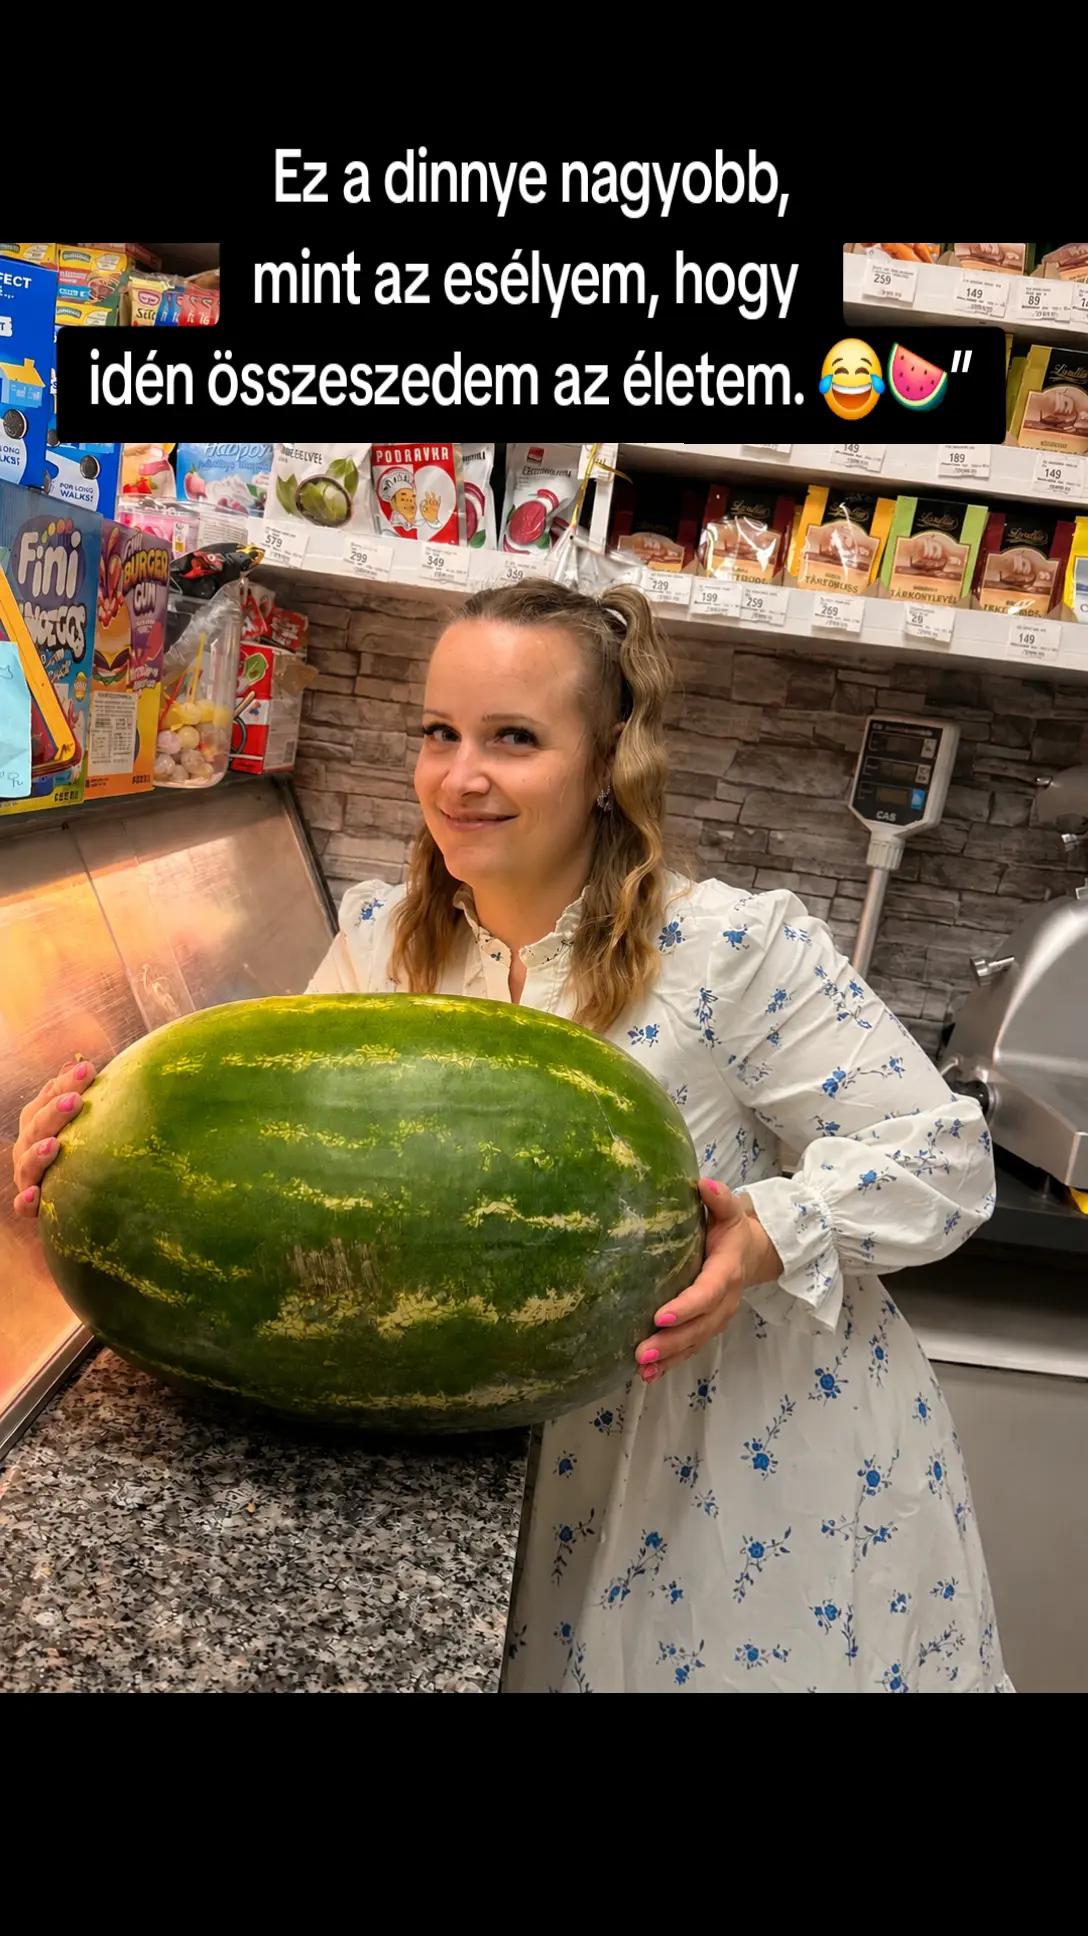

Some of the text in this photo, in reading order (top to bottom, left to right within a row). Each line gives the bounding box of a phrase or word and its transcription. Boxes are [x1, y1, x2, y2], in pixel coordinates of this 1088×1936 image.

[873, 273, 892, 285] 259
[966, 287, 983, 299] 149
[1027, 295, 1041, 306] 89
[376, 447, 449, 463] PODRAVKA
[949, 453, 965, 464] 189
[1044, 468, 1062, 480] 149
[74, 486, 94, 494] LONG
[265, 534, 283, 548] 579
[350, 551, 368, 564] 299
[426, 556, 445, 568] 349
[18, 531, 81, 599] Fini
[124, 549, 168, 588] BURGER
[746, 597, 763, 608] 259
[822, 606, 839, 617] 269
[1019, 633, 1035, 644] 149
[876, 810, 897, 822] CAS
